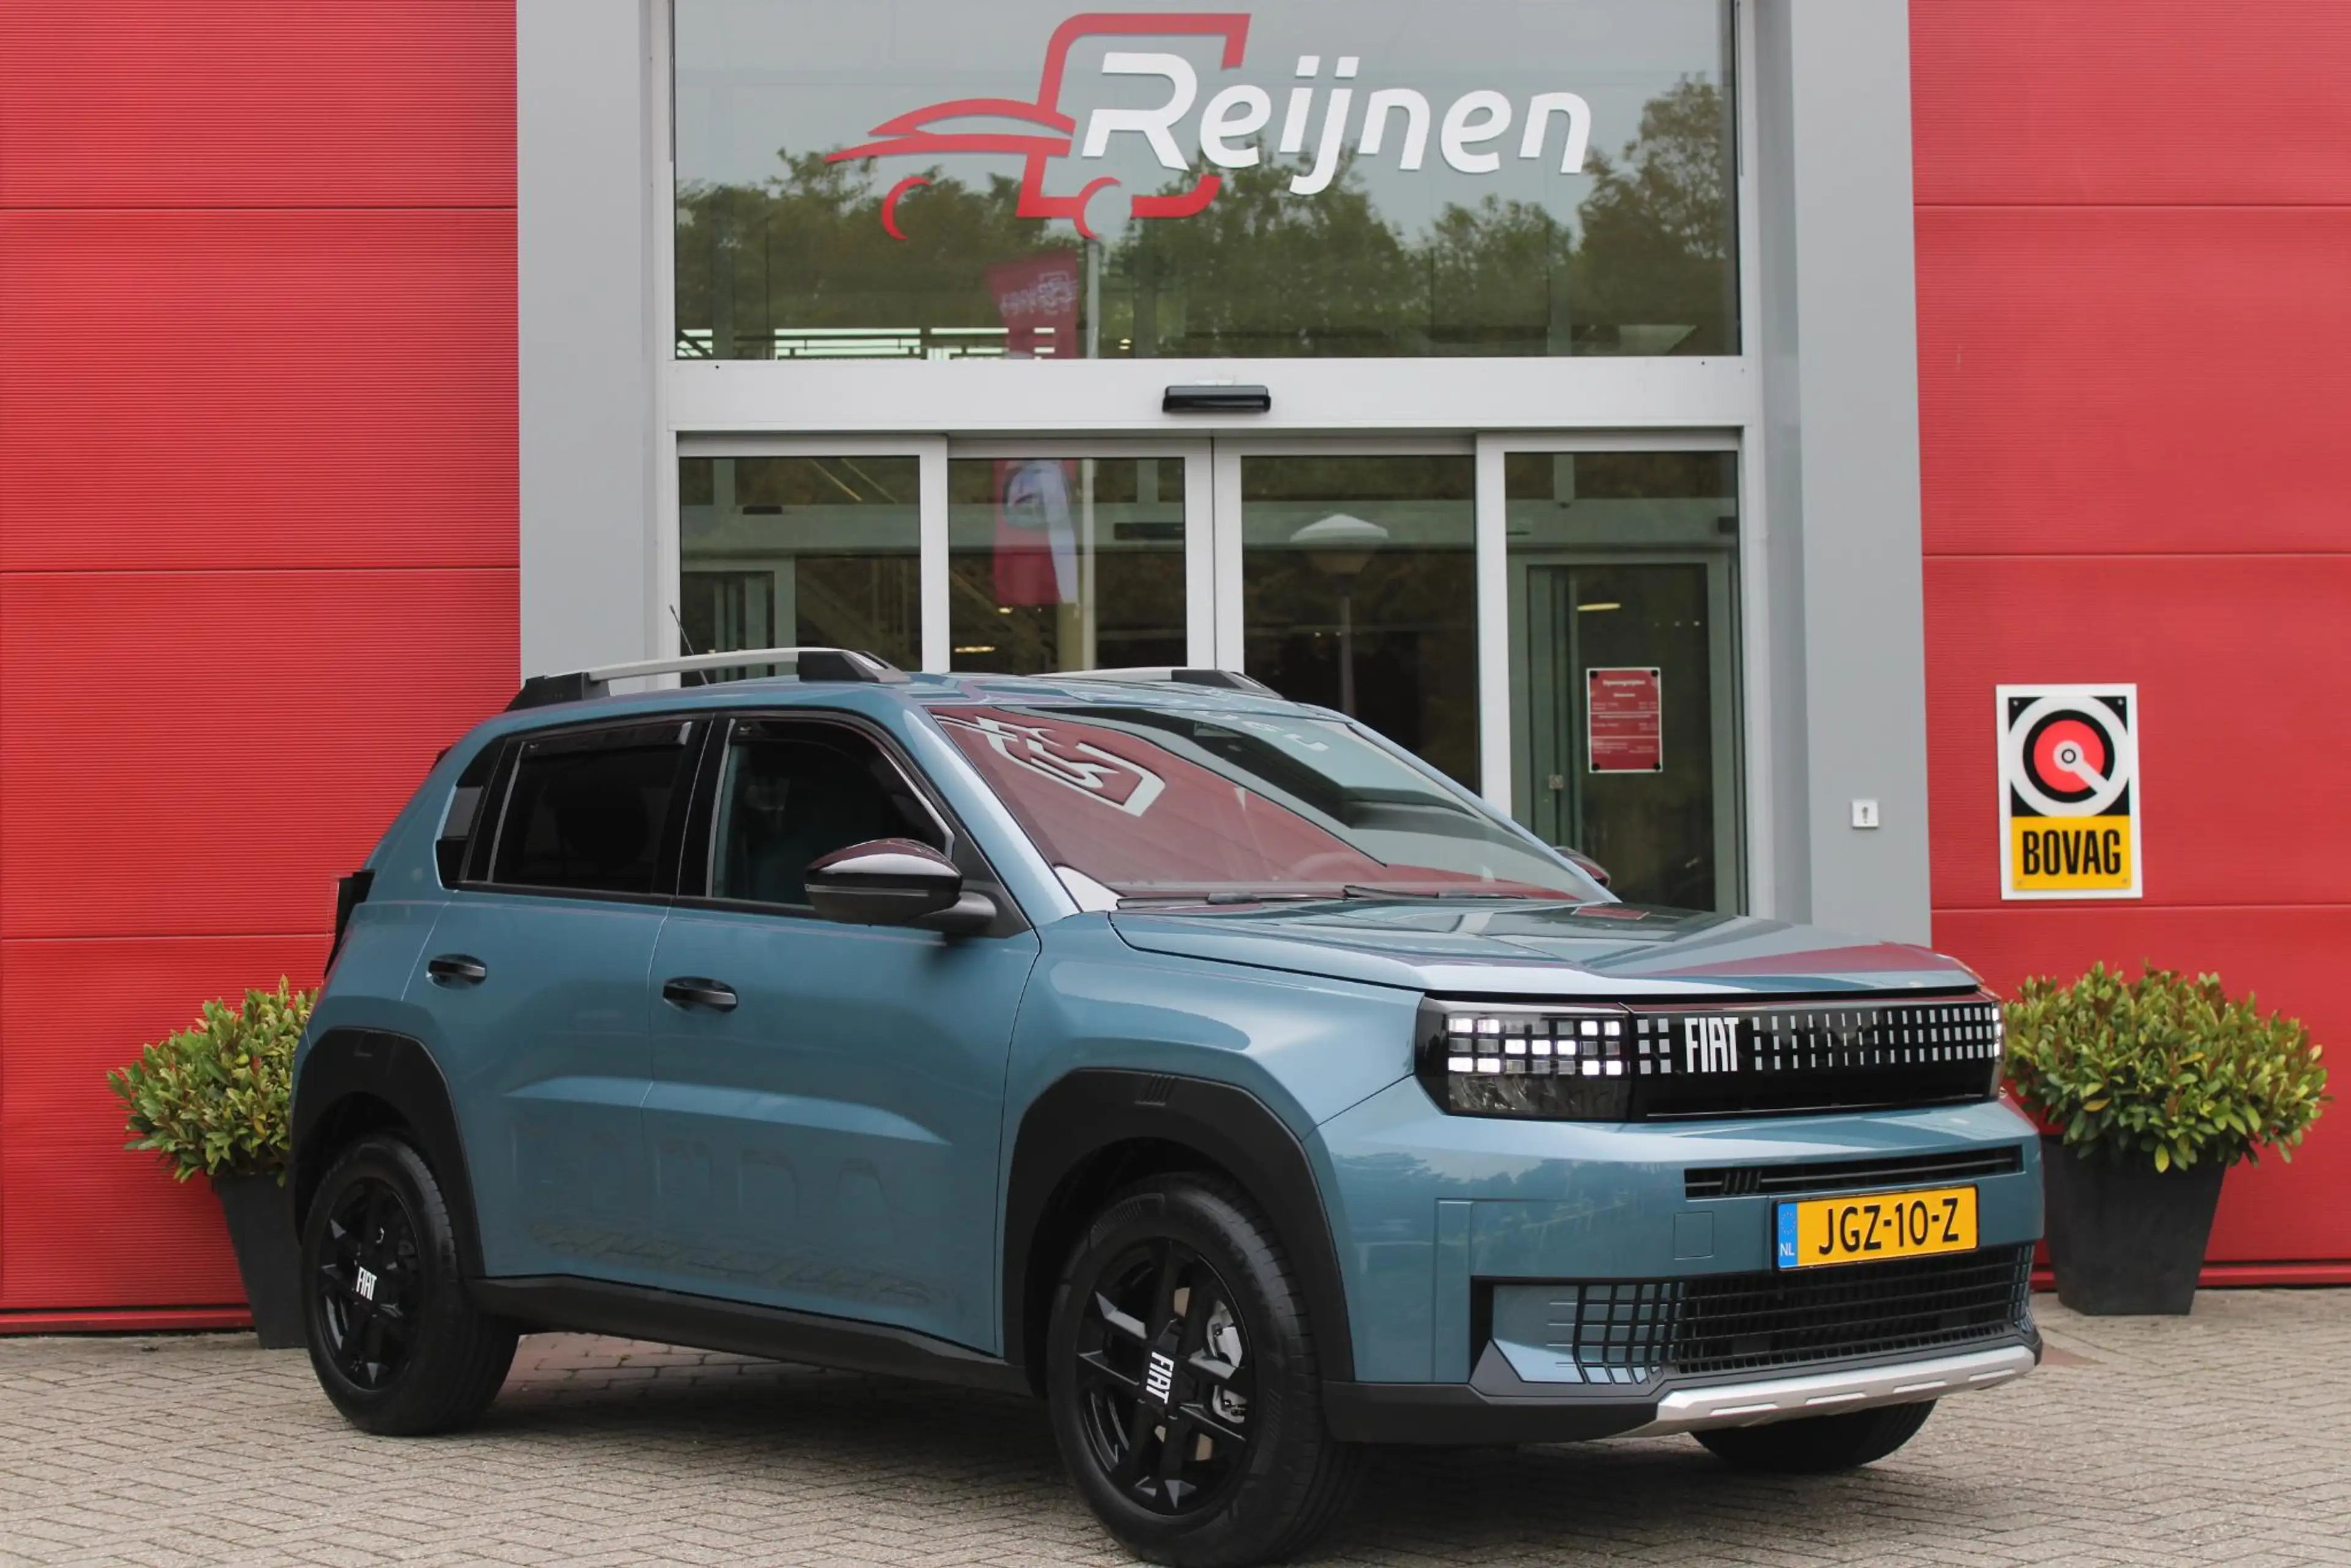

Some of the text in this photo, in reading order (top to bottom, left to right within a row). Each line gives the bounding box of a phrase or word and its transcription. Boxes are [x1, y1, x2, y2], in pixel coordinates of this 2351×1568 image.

[1082, 53, 1591, 195] Reijnen
[2022, 829, 2121, 876] BOVAG
[1684, 1016, 1739, 1073] FIAT
[1780, 1197, 1959, 1256] NL JGZ-10-Z
[356, 1266, 378, 1301] FIAT
[1146, 1351, 1174, 1405] FIAT
